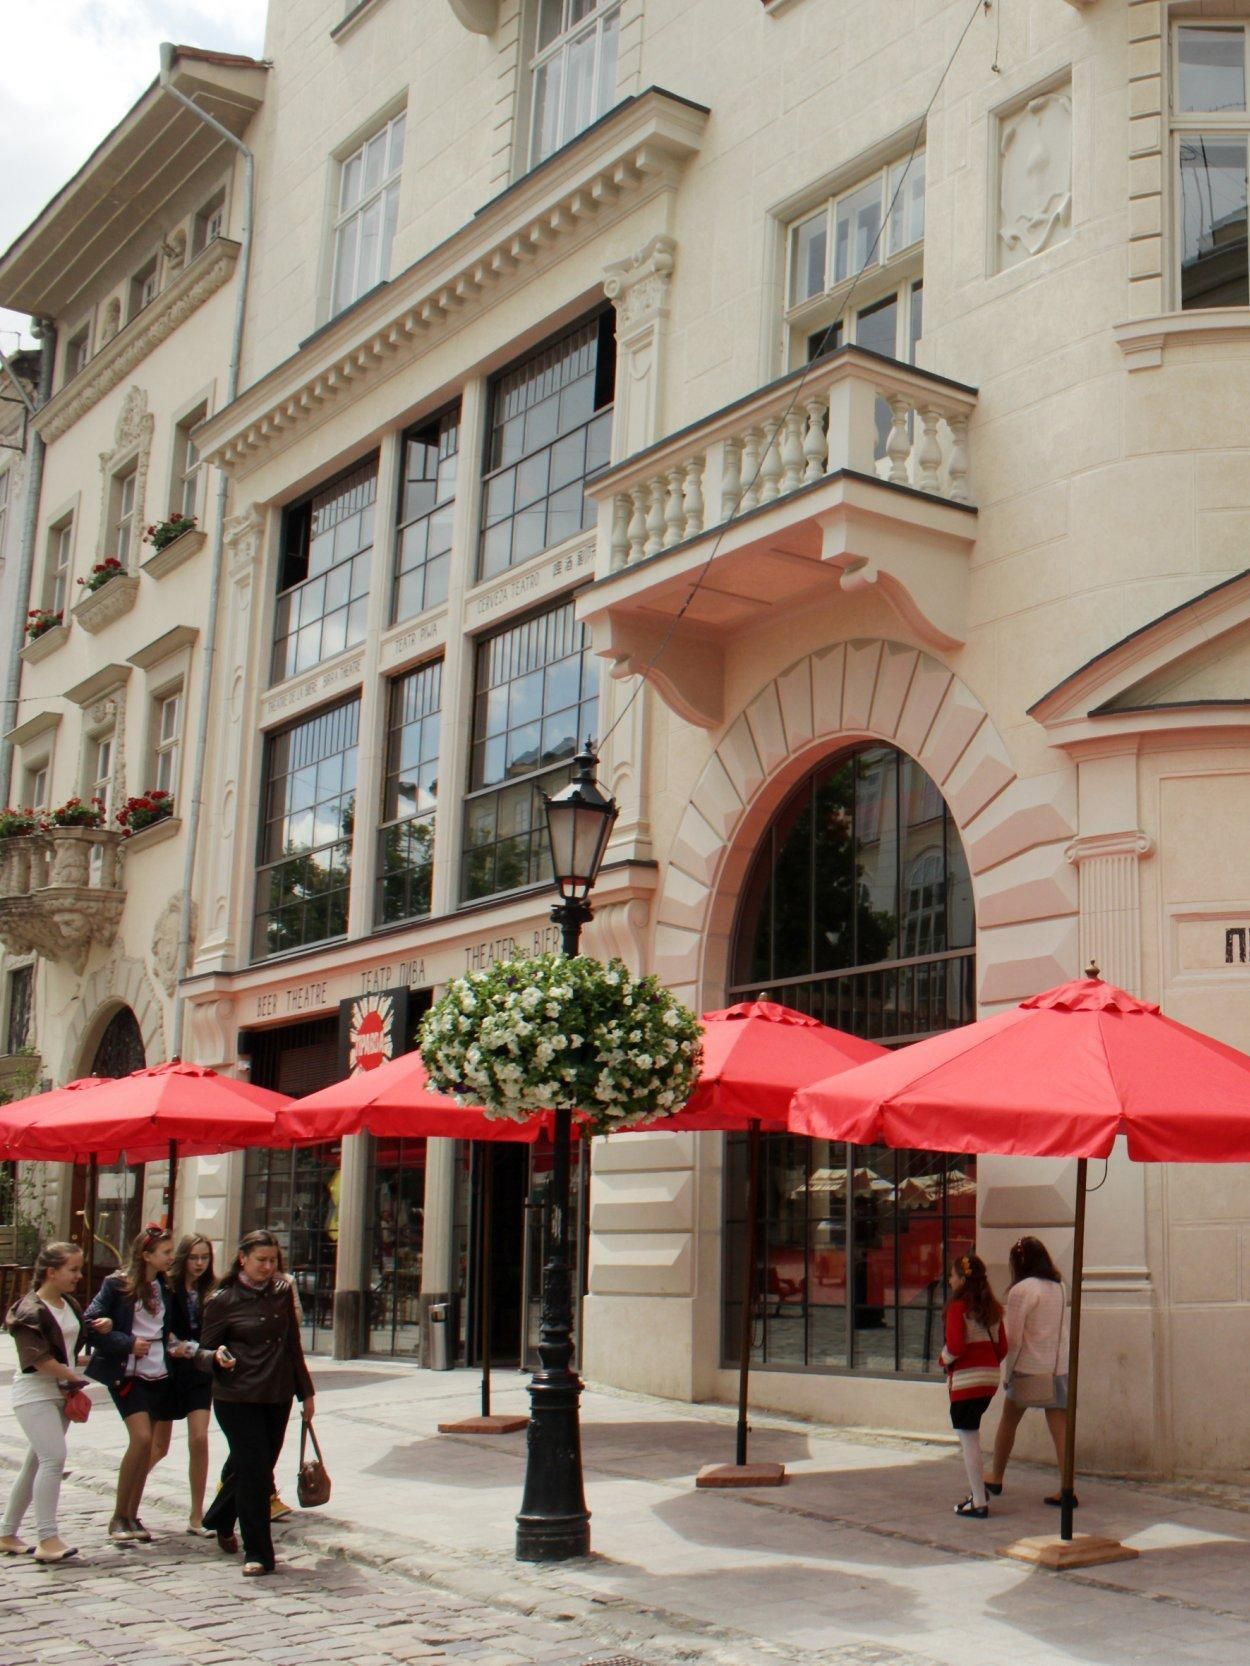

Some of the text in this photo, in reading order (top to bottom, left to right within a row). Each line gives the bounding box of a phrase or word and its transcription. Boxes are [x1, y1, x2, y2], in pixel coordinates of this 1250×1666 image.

[511, 572, 539, 596] TEATRO
[395, 632, 416, 654] TEATR
[361, 959, 426, 995] ТЕАТР ПИВА
[256, 982, 327, 1017] BEER THEATRE
